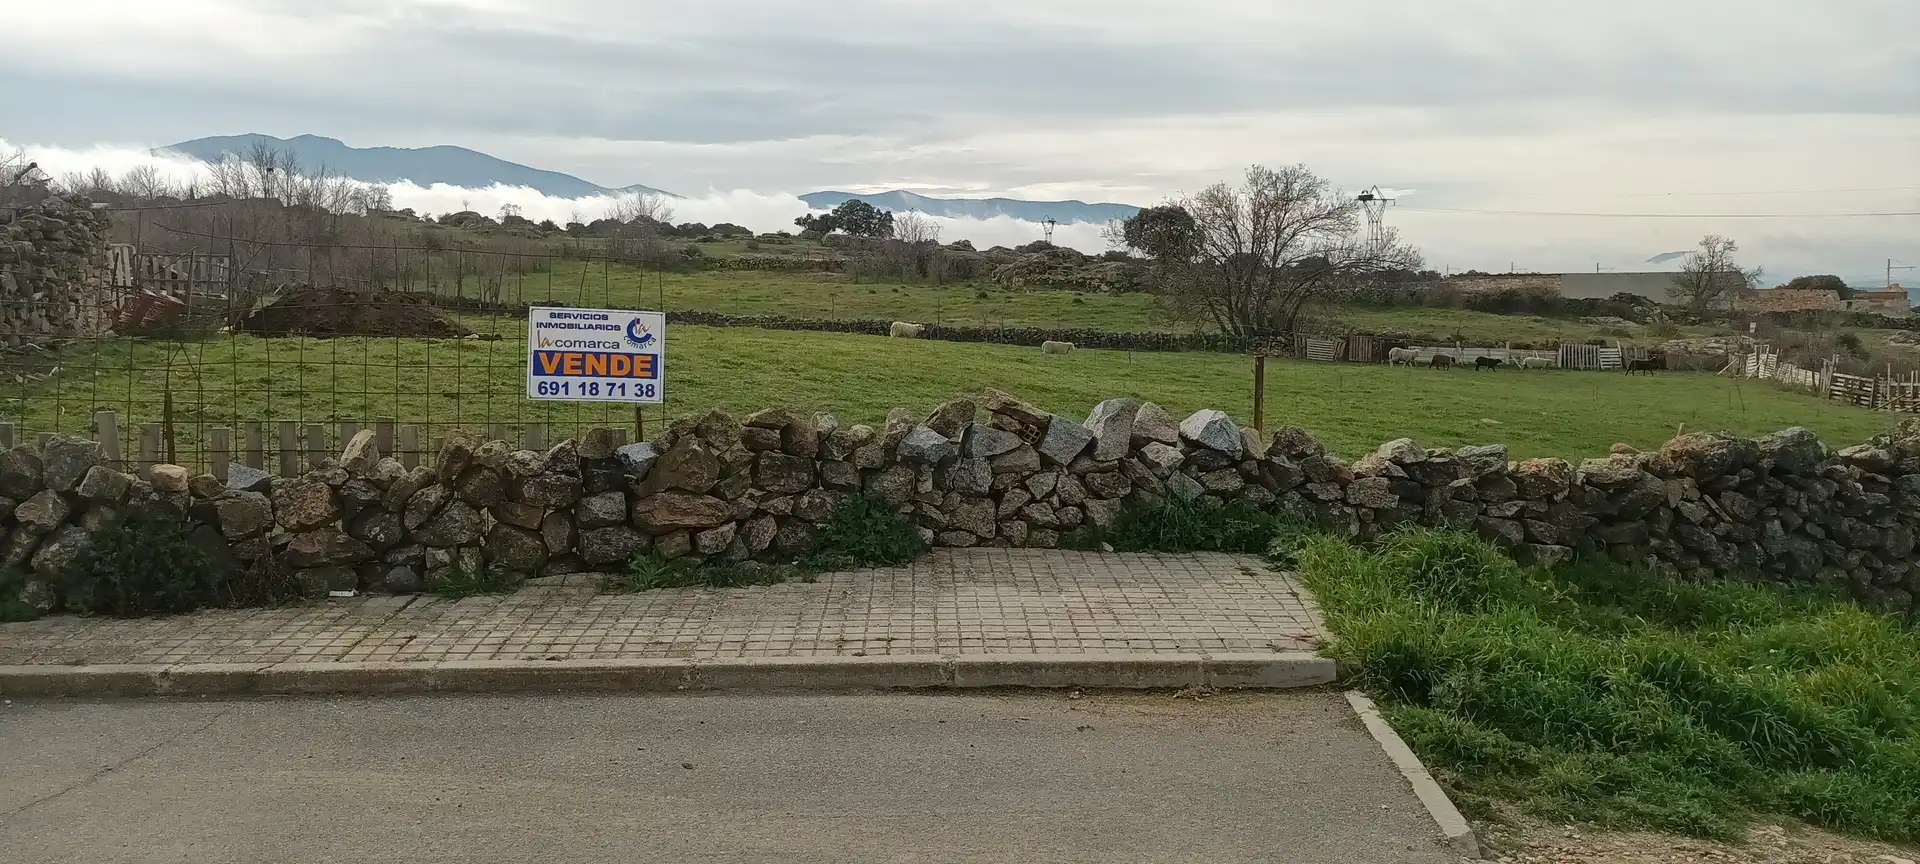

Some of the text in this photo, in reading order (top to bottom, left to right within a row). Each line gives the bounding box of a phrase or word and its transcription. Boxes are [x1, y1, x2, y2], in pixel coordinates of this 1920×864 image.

[549, 312, 609, 321] SERVICIOS
[536, 321, 622, 331] INMOBILIARIOS
[554, 339, 620, 350] comarca
[623, 335, 657, 350] comarca
[538, 352, 653, 377] VENDE
[537, 381, 656, 398] 691 18 71 38
